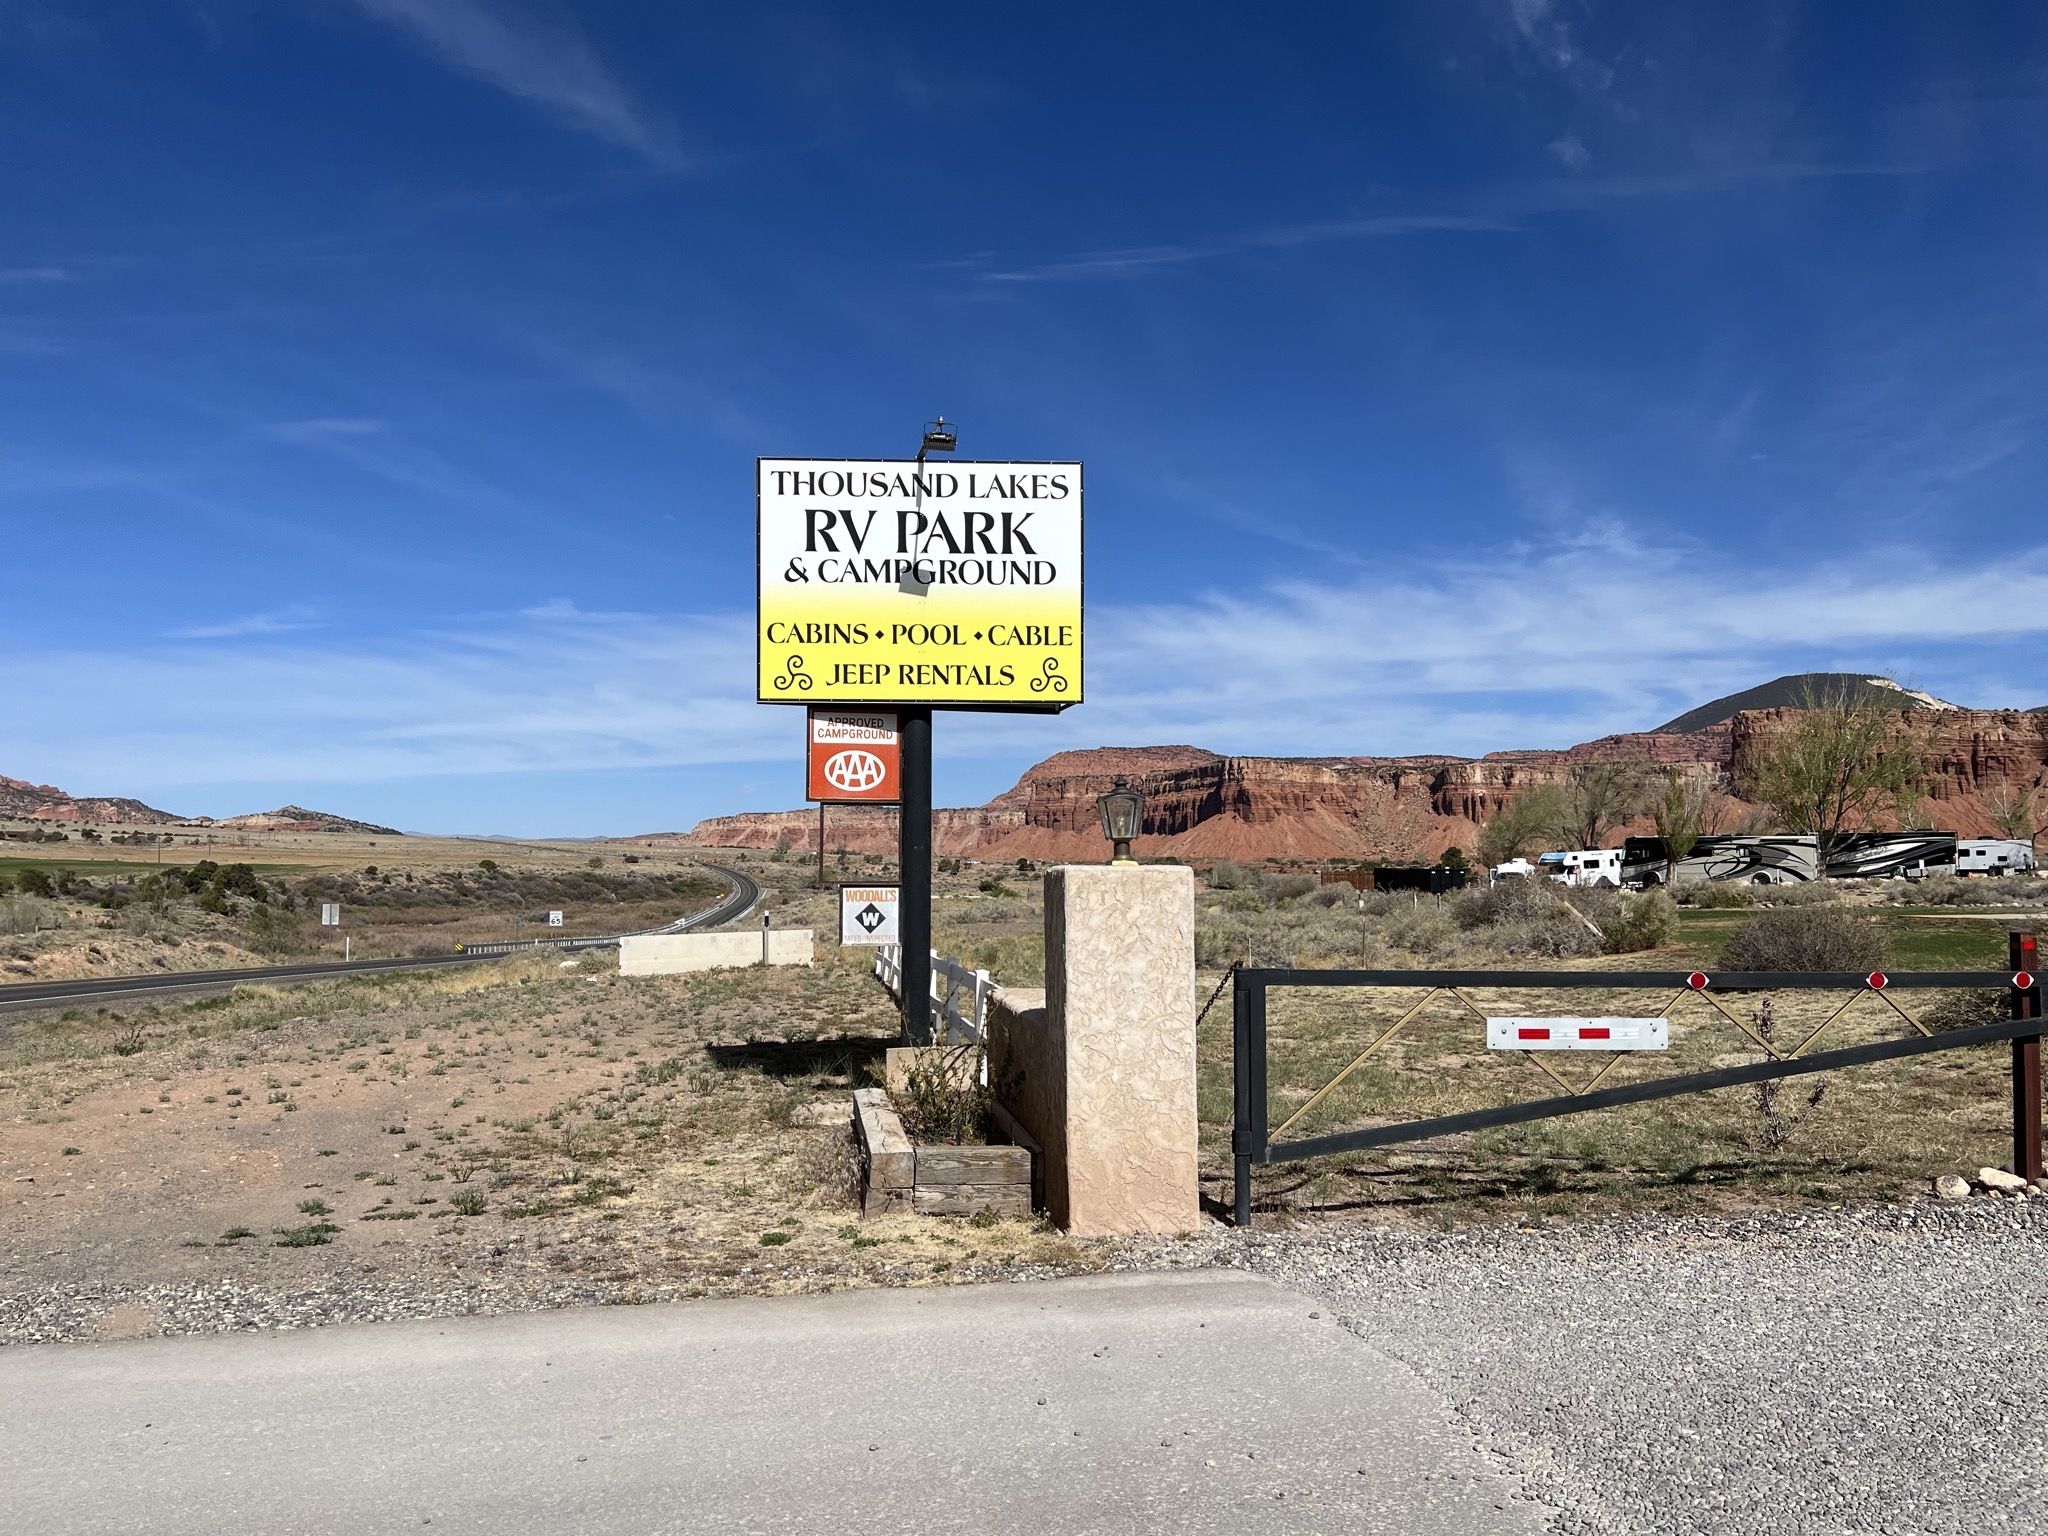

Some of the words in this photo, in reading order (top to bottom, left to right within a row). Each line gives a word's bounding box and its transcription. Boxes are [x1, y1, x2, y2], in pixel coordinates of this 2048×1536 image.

[770, 471, 958, 498] THOUSAND
[968, 474, 1069, 499] LAKES
[804, 509, 877, 554] RV
[896, 510, 1037, 555] PARK
[784, 557, 809, 584] &
[817, 558, 1057, 585] CAMPGROUND
[766, 622, 868, 644] CABINS
[891, 624, 967, 646] POOL
[987, 625, 1073, 647] CABLE
[825, 664, 890, 686] JEEP
[898, 664, 1015, 686] RENTALS
[817, 728, 893, 739] CAMPGROUND
[827, 717, 884, 728] APPROVED
[830, 751, 880, 789] AAA
[845, 889, 897, 902] WOODALL'S
[861, 912, 880, 927] W
